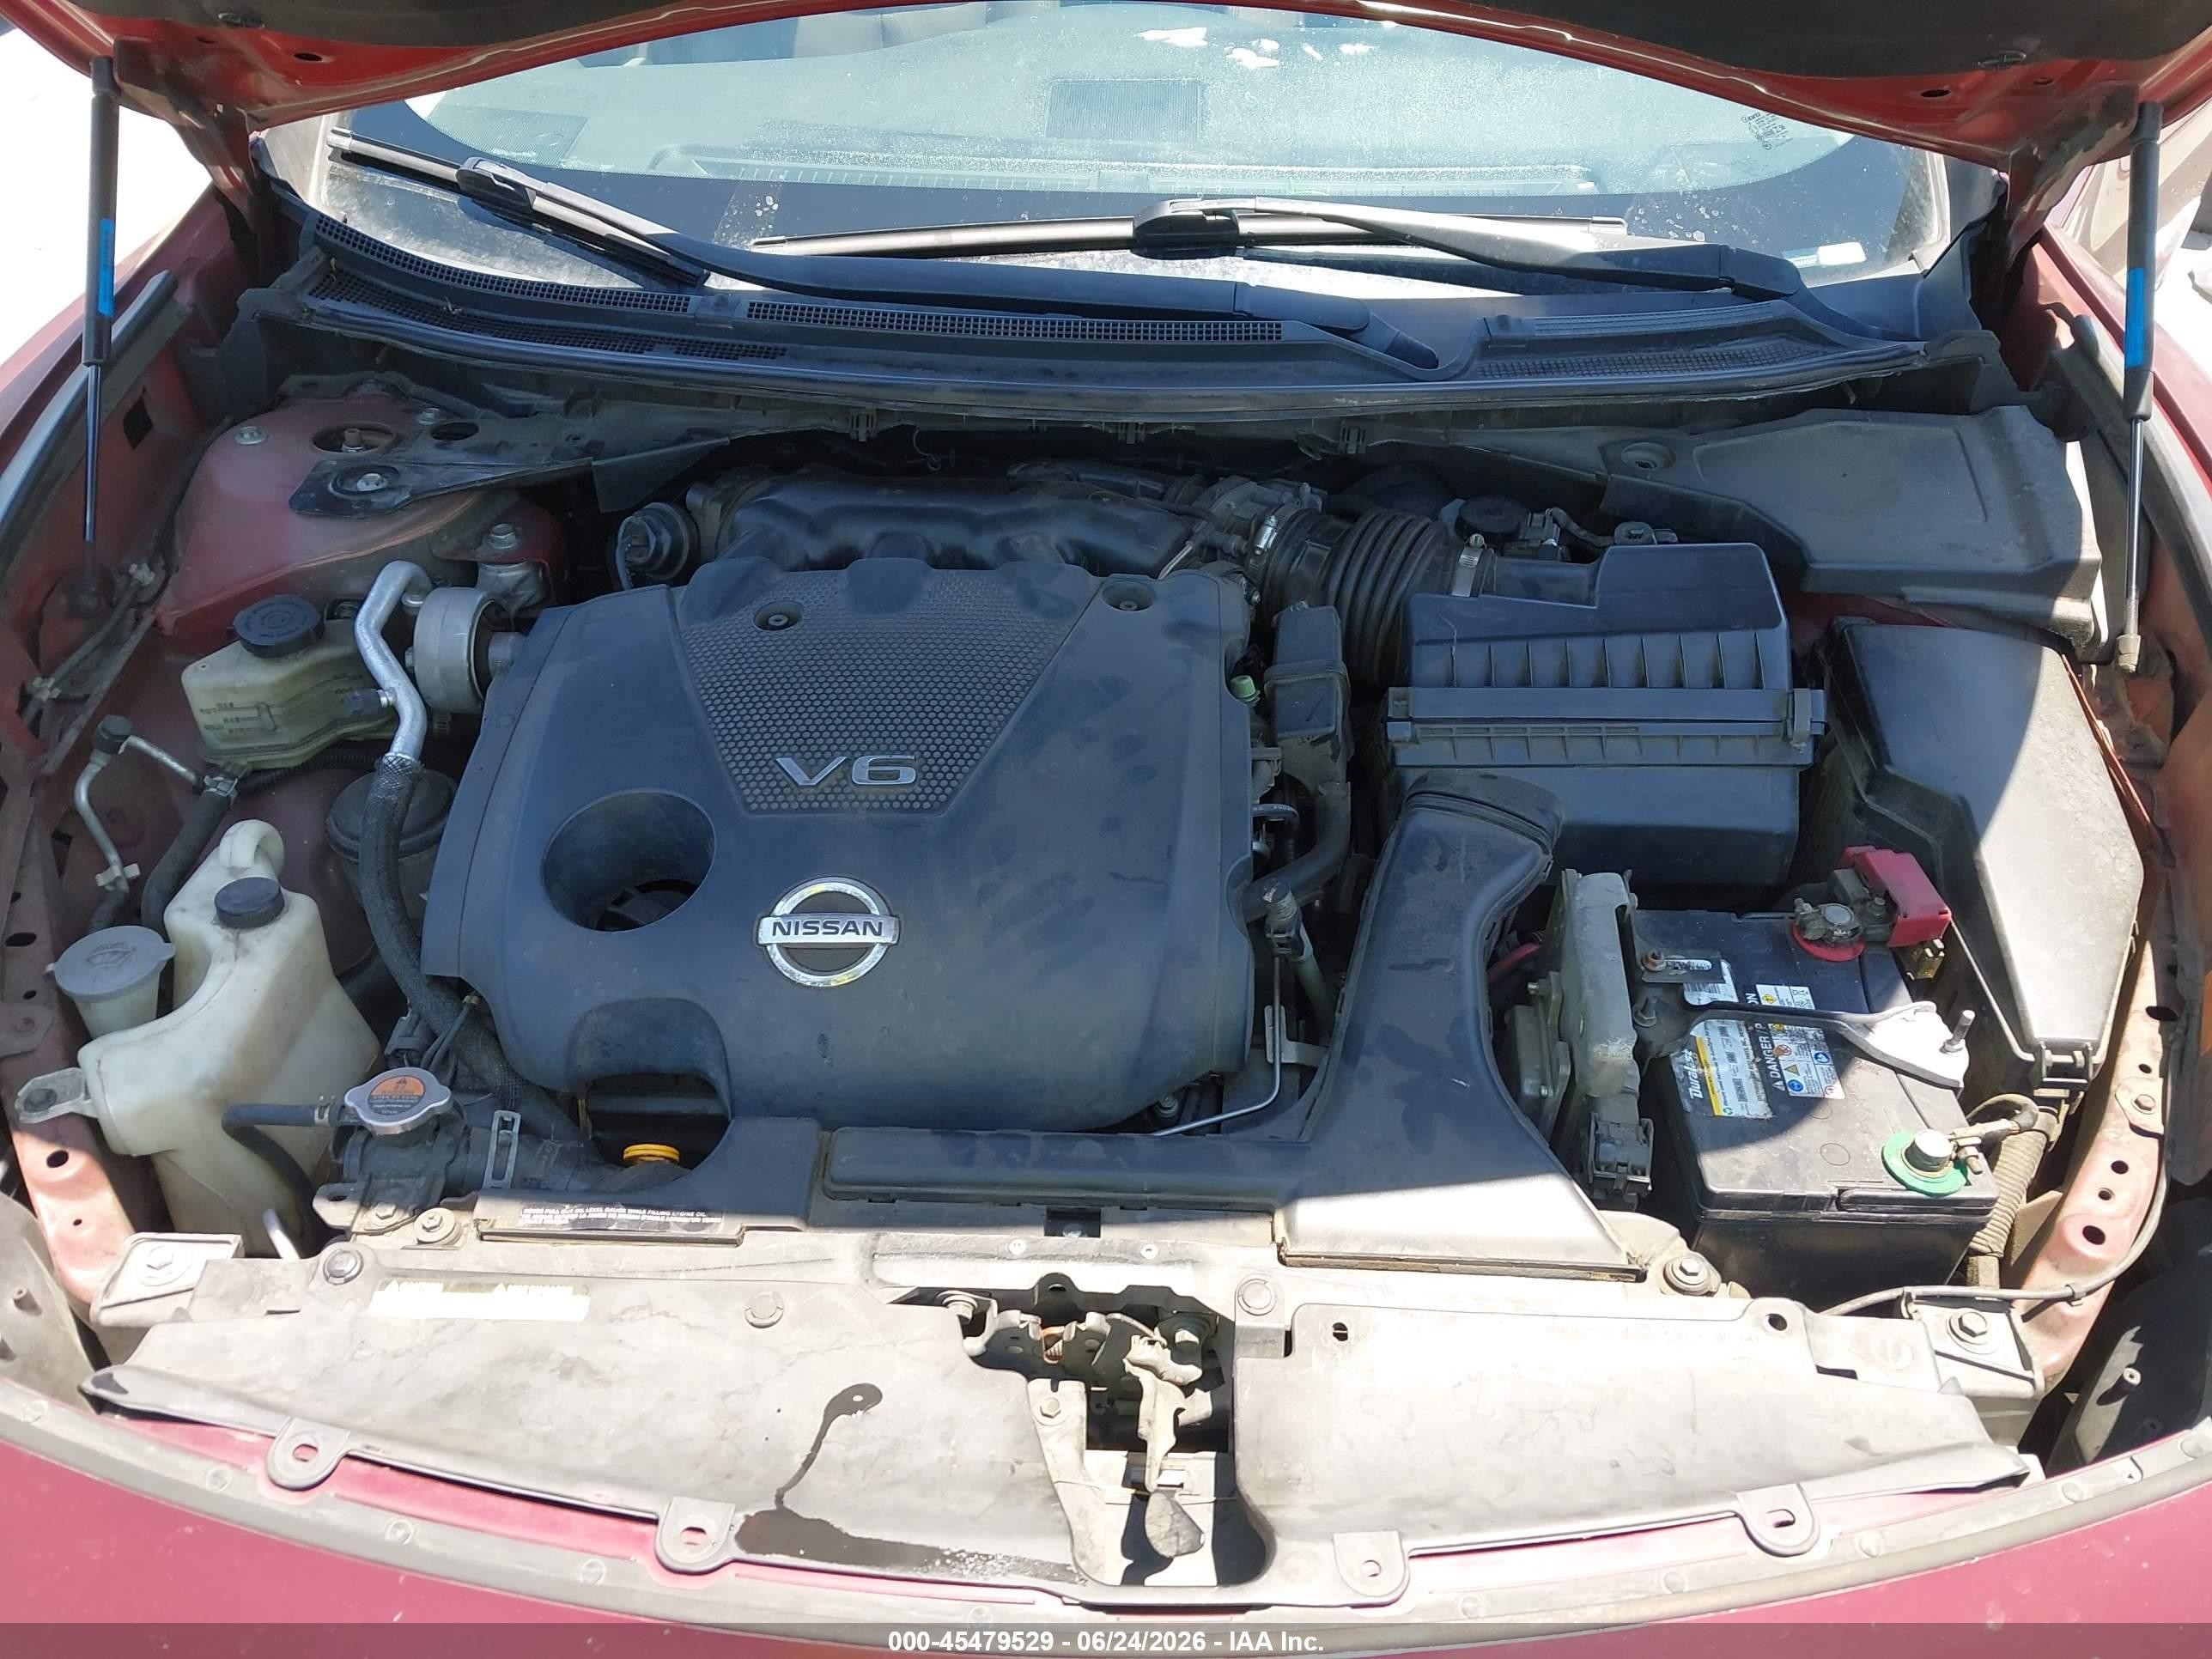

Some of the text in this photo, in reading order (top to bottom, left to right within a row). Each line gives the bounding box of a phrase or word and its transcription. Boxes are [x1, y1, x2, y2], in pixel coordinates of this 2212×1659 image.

[775, 755, 918, 786] V6
[772, 920, 883, 937] NISSAN
[1759, 1035, 1781, 1079] DANGER
